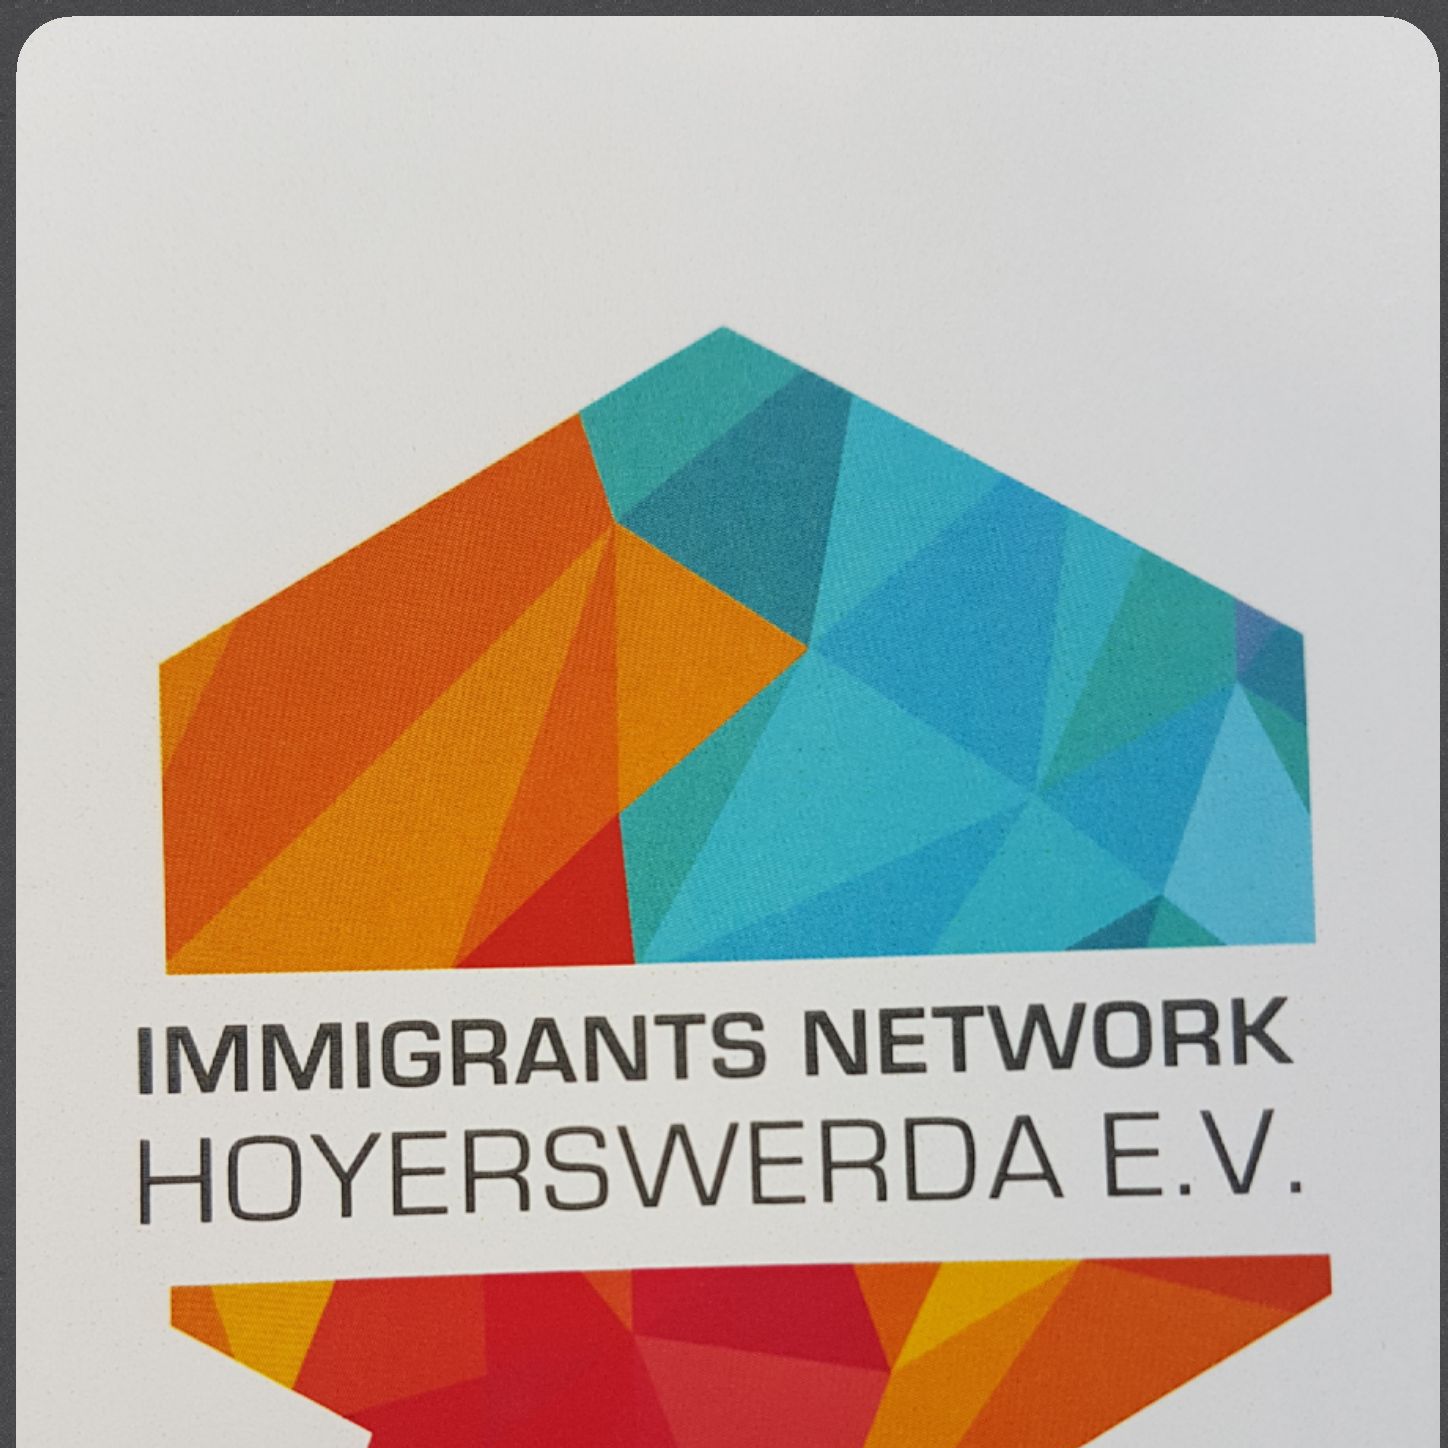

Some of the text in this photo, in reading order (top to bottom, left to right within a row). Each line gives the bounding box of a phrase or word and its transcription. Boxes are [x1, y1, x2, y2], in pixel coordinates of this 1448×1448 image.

[136, 995, 1294, 1096] IMMIGRANTS NETWORK
[137, 1107, 1305, 1226] HOYERSWERDA E.V.
